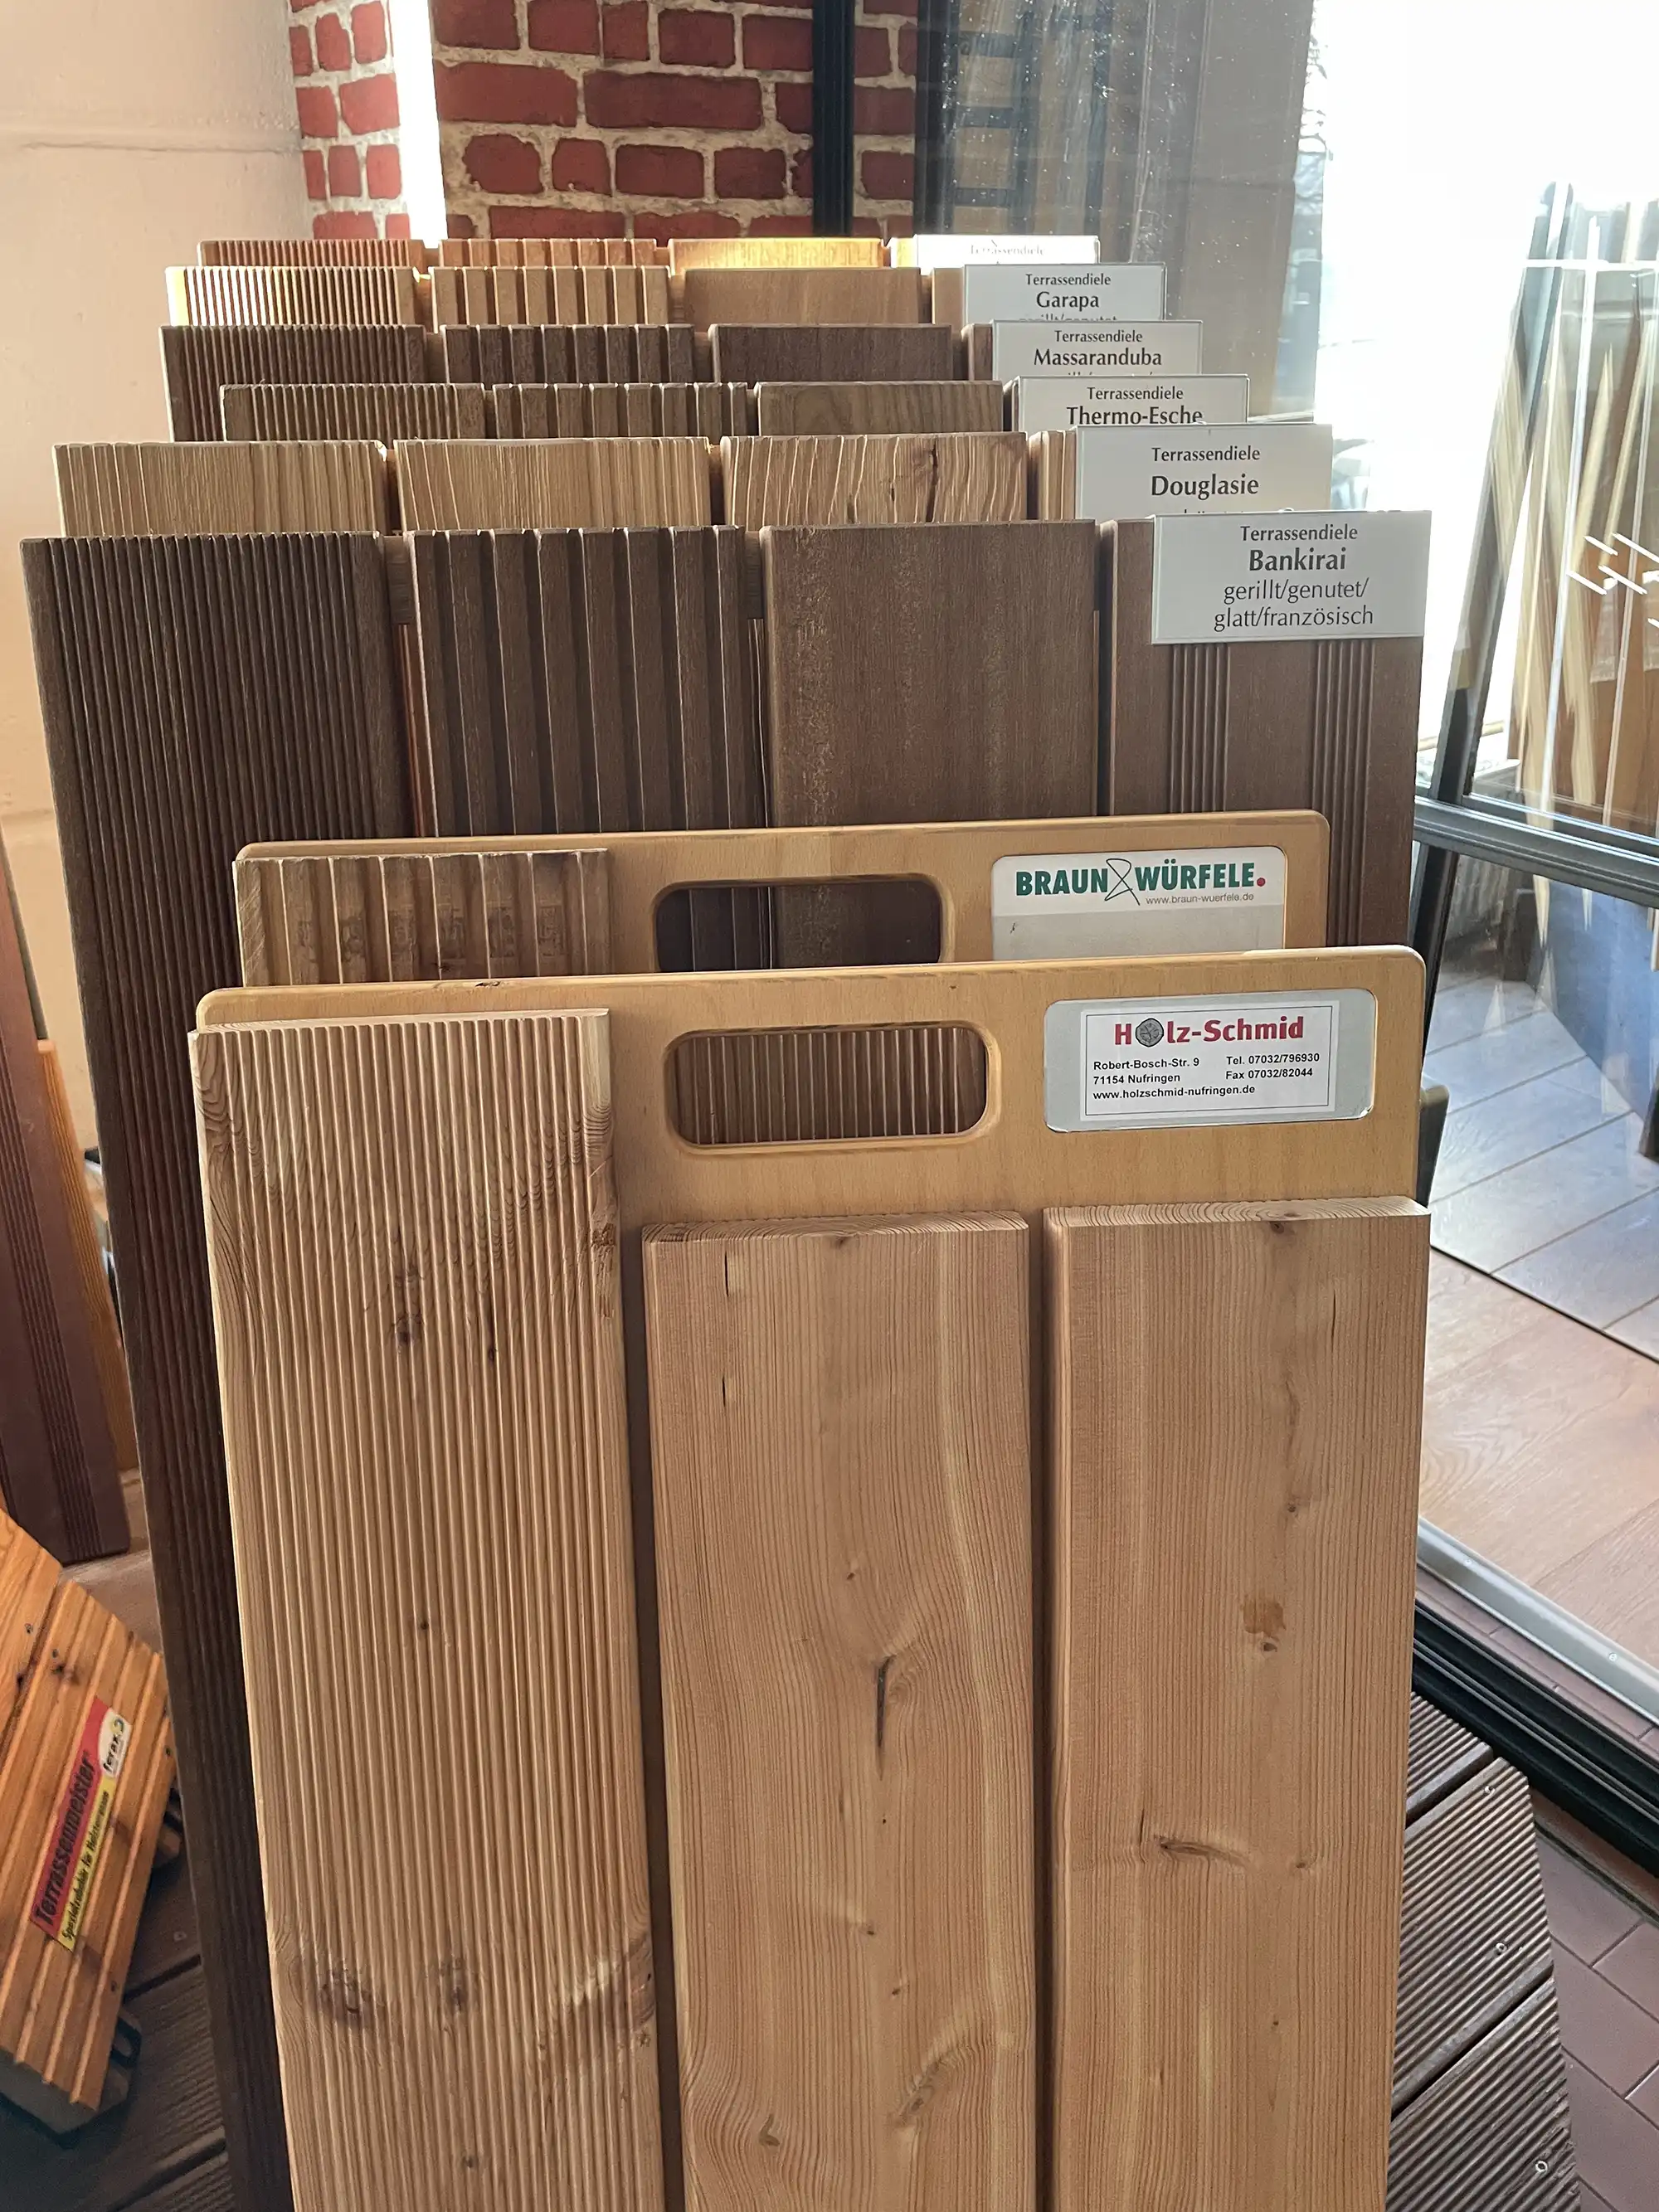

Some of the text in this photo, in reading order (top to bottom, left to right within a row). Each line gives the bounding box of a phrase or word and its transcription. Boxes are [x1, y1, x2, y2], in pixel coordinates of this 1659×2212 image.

[1024, 272, 1112, 286] Terrassendiele
[1036, 290, 1100, 313] Garapa
[1053, 329, 1144, 343] Terrassendiele
[1033, 347, 1163, 367] Massaranduba
[1086, 385, 1185, 401] Terrassendiele
[1066, 405, 1204, 425] Thermo-Esche
[1151, 445, 1262, 463] Terrassendiele
[1151, 473, 1260, 501] Douglasie
[1239, 523, 1359, 542] Terrassendiele
[1248, 547, 1347, 572] Bankirai
[1223, 576, 1370, 605] gerillt/genutet/
[1213, 606, 1374, 633] glatt/französisch
[1015, 868, 1109, 897] BRAUN
[1146, 892, 1255, 906] www.braun-wuerfele.de
[1093, 1057, 1199, 1071] Robert-Bosch-Str. 9
[1226, 1053, 1321, 1066] Tel. 07032/796930
[1093, 1073, 1181, 1087] 71154 Nufringen
[1225, 1067, 1313, 1080] Fax 07032/82044
[1092, 1085, 1256, 1100] www.holzschmid-nufringen.de
